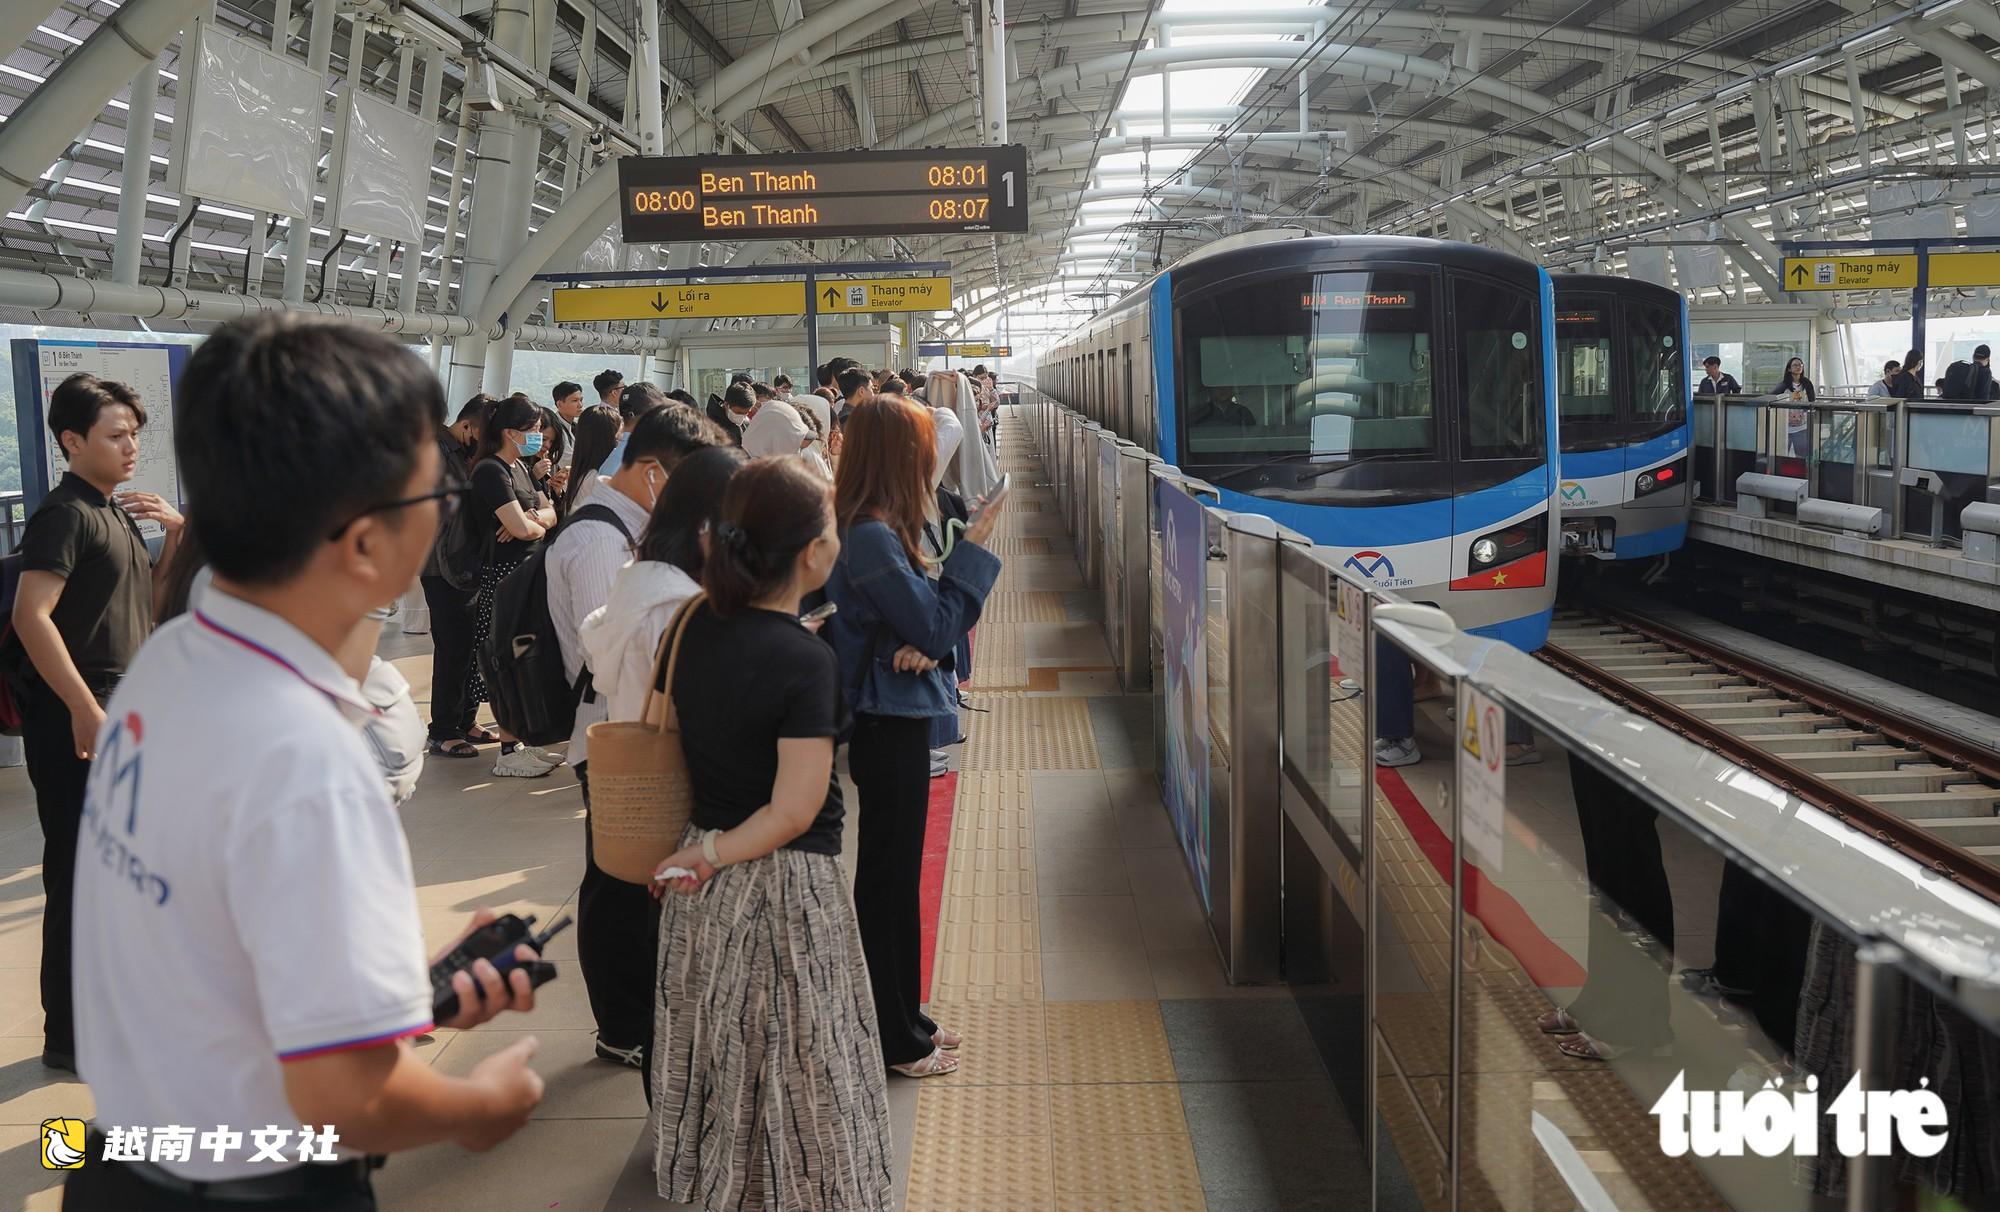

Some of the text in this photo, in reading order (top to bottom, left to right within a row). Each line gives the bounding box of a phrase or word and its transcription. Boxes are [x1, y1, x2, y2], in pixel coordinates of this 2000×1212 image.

[701, 165, 986, 193] Ben Thanh 08:01
[1001, 171, 1014, 207] 1
[634, 190, 695, 212] 08:00
[702, 198, 990, 227] Ben Thanh 08:07
[1839, 261, 1901, 275] Thang máy
[1838, 276, 1871, 285] Elevator
[678, 289, 710, 301] Lối ra
[871, 283, 933, 297] Thang máy
[679, 304, 694, 313] Exit
[871, 298, 903, 307] Elevator
[1393, 577, 1413, 587] Tiên
